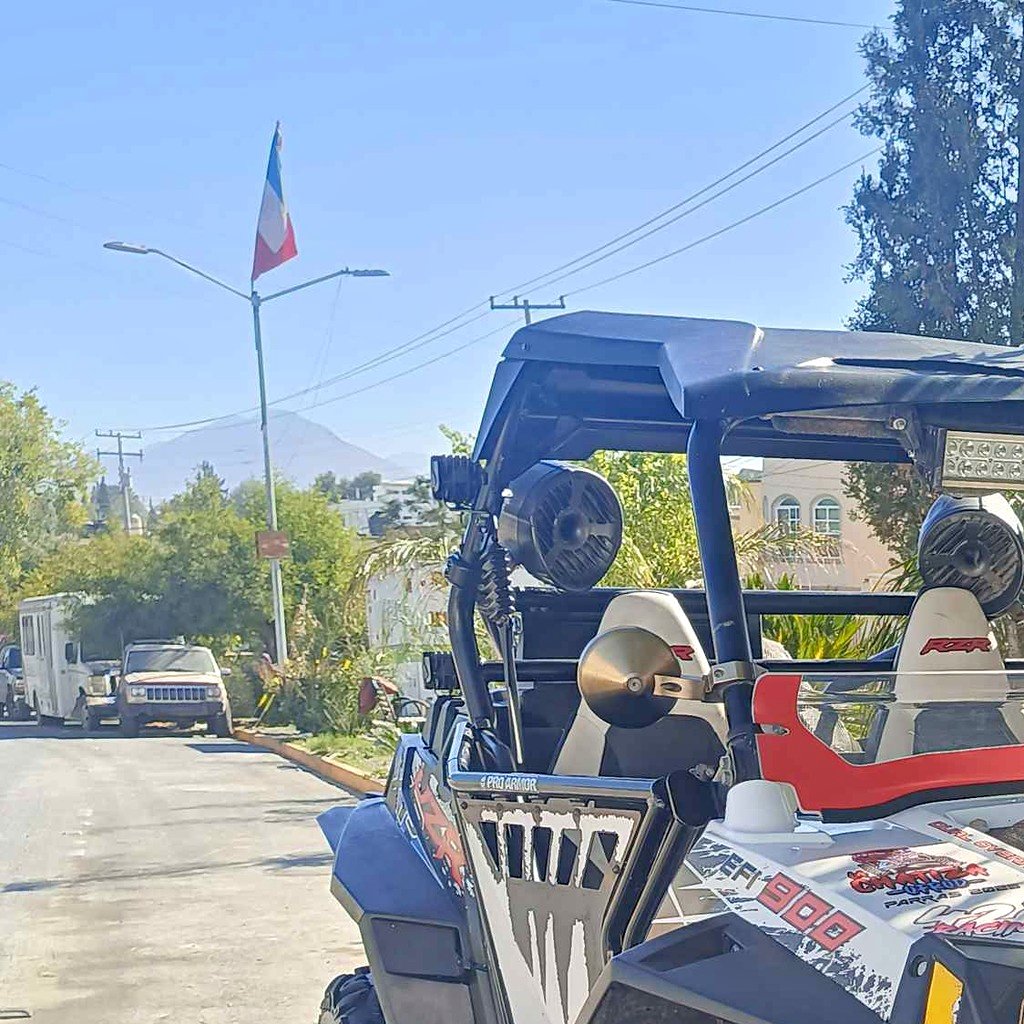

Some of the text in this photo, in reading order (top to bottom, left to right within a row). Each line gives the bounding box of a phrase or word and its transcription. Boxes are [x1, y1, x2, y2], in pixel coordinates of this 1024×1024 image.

[920, 637, 991, 655] RZR
[486, 775, 537, 791] PRO ARMOR
[720, 852, 867, 951] EFI 900
[884, 890, 962, 910] PARRAS
